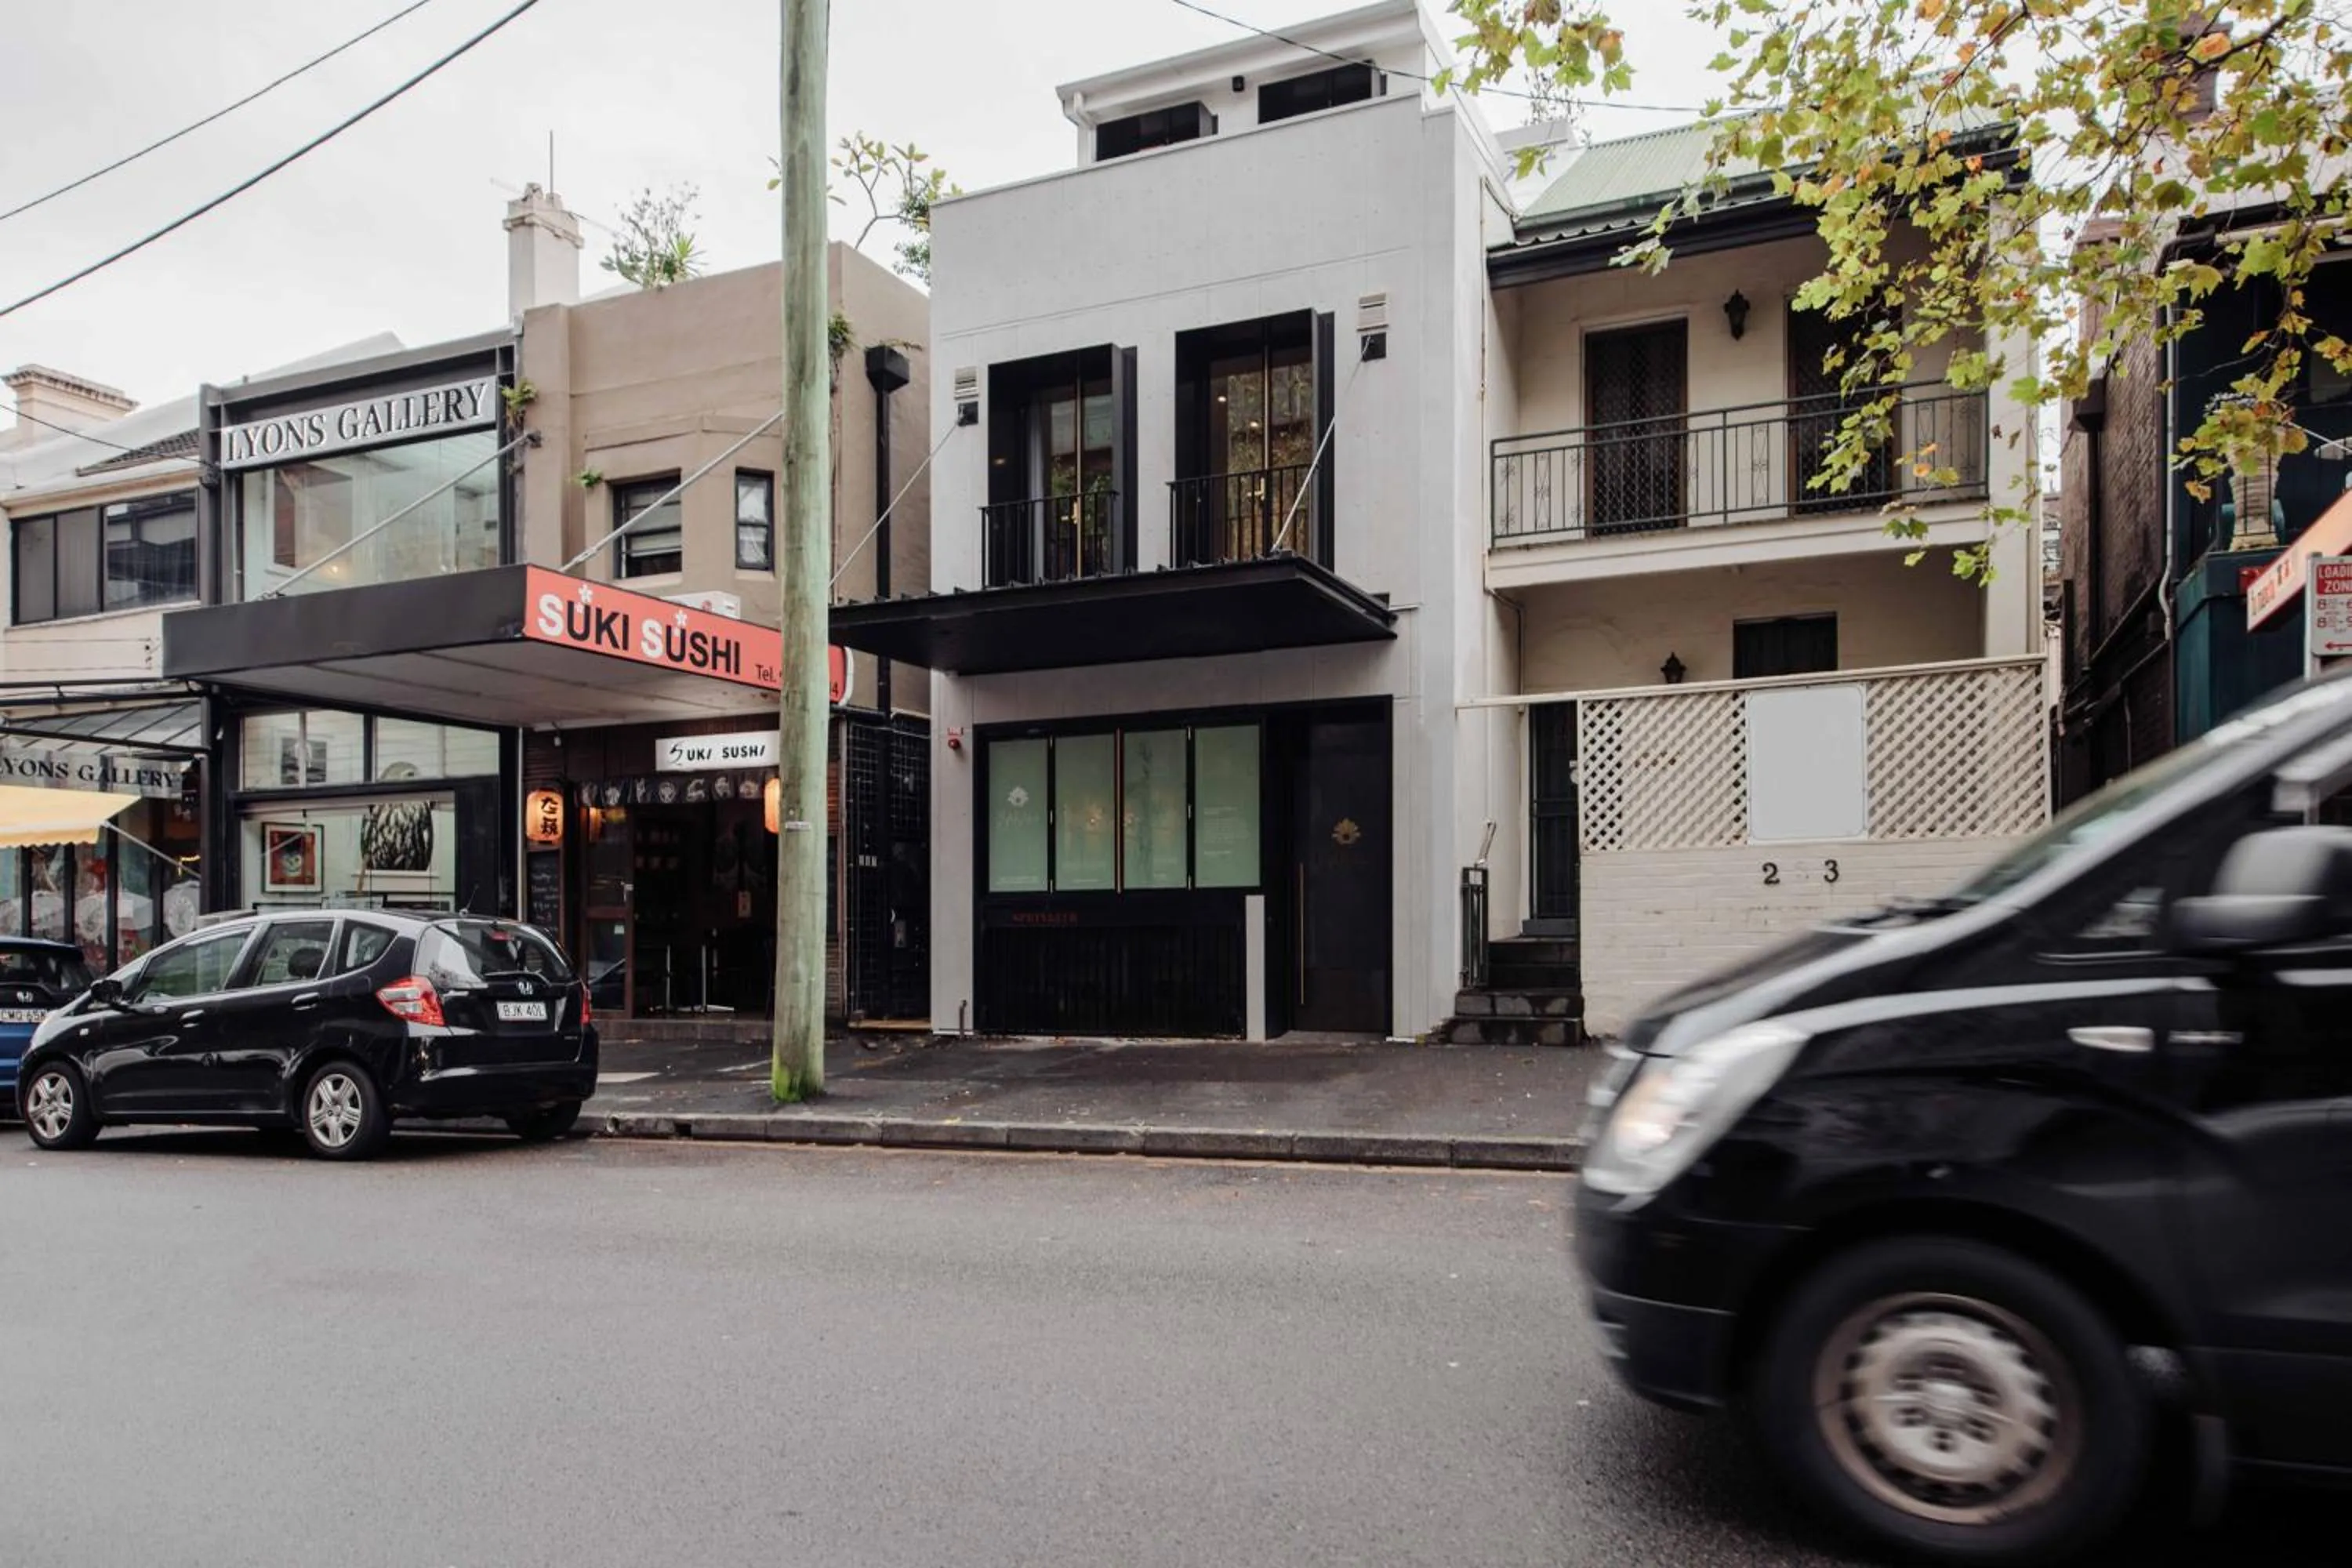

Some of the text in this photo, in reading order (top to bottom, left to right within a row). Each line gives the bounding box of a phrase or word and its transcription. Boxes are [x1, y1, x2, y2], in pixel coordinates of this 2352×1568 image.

[228, 382, 488, 462] LYONS GALLERY
[2324, 580, 2352, 593] ZON
[538, 593, 741, 675] SUKI SUSHI
[755, 664, 777, 683] Tel.
[722, 744, 766, 758] SUSHI
[0, 757, 176, 788] YONS GALLERY
[1762, 858, 1840, 885] 2 3
